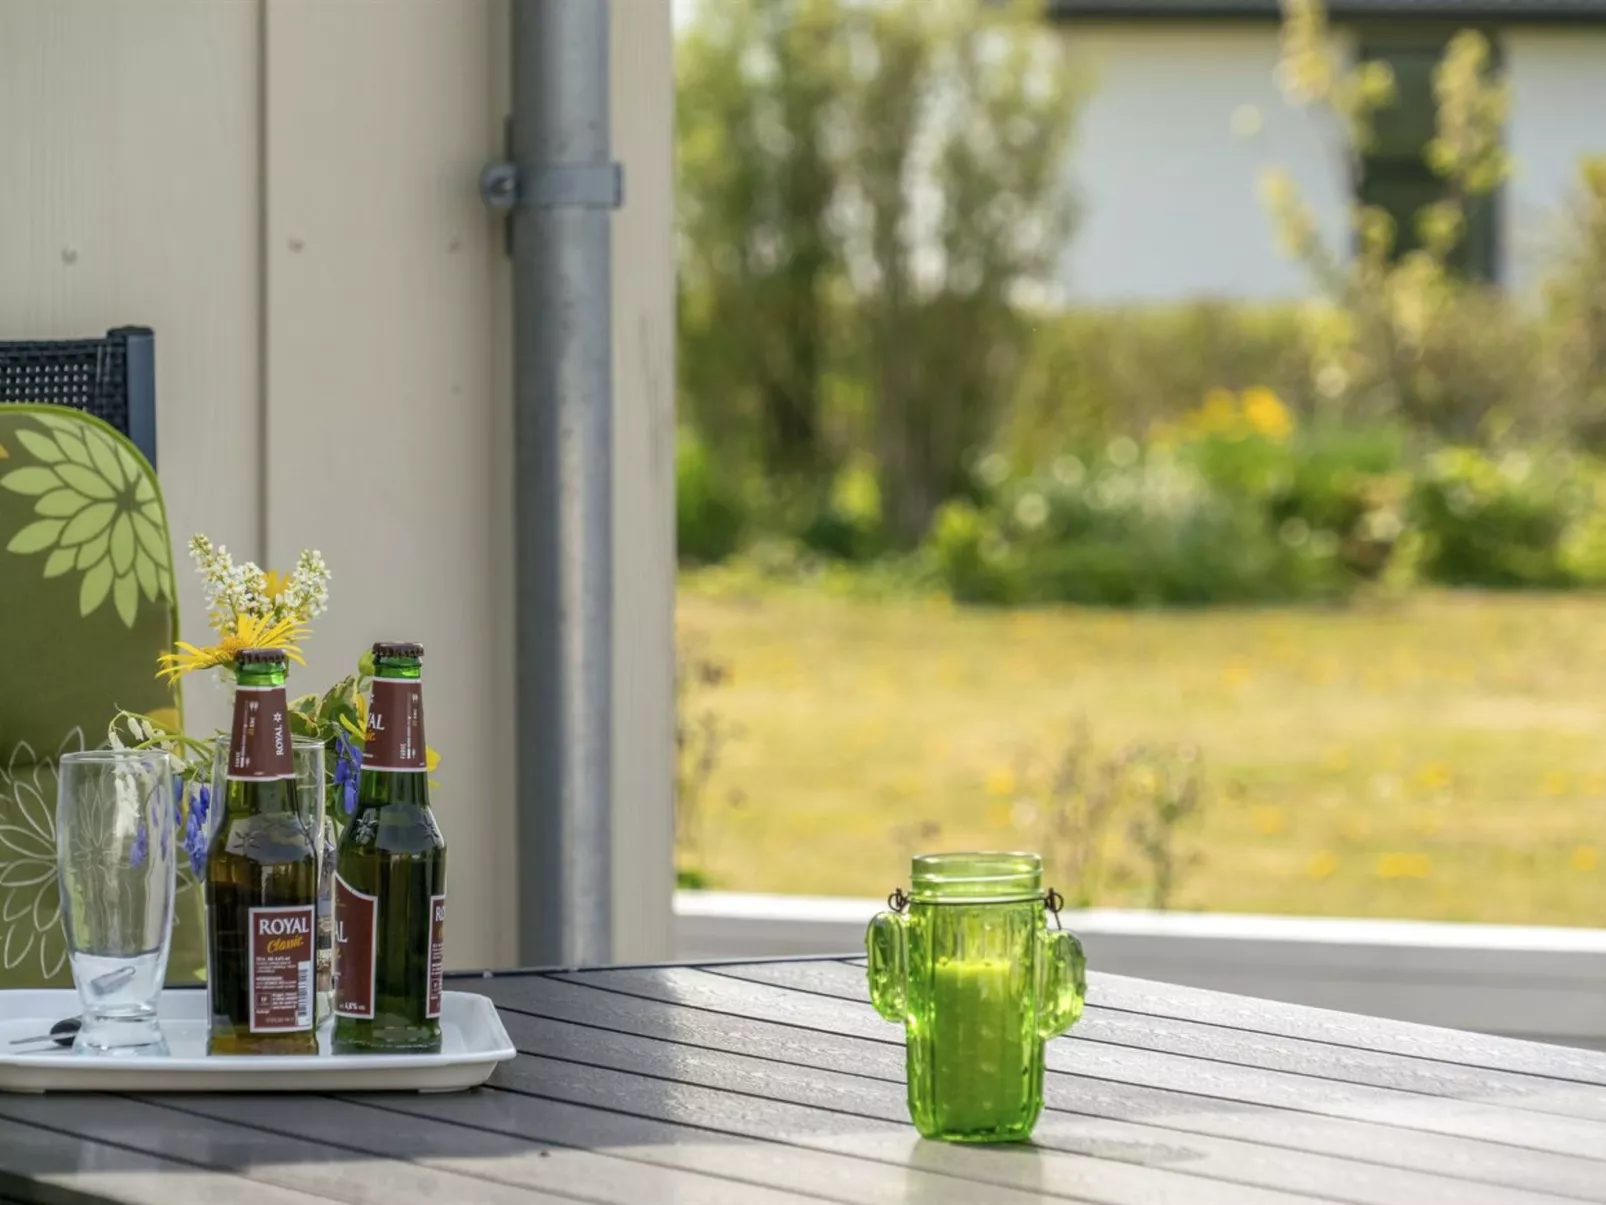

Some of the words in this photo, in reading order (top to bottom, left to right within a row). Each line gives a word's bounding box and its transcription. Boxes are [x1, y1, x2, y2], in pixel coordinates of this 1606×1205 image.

[275, 724, 284, 756] ROYAL
[259, 917, 310, 936] ROYAL
[266, 935, 304, 954] Classic
